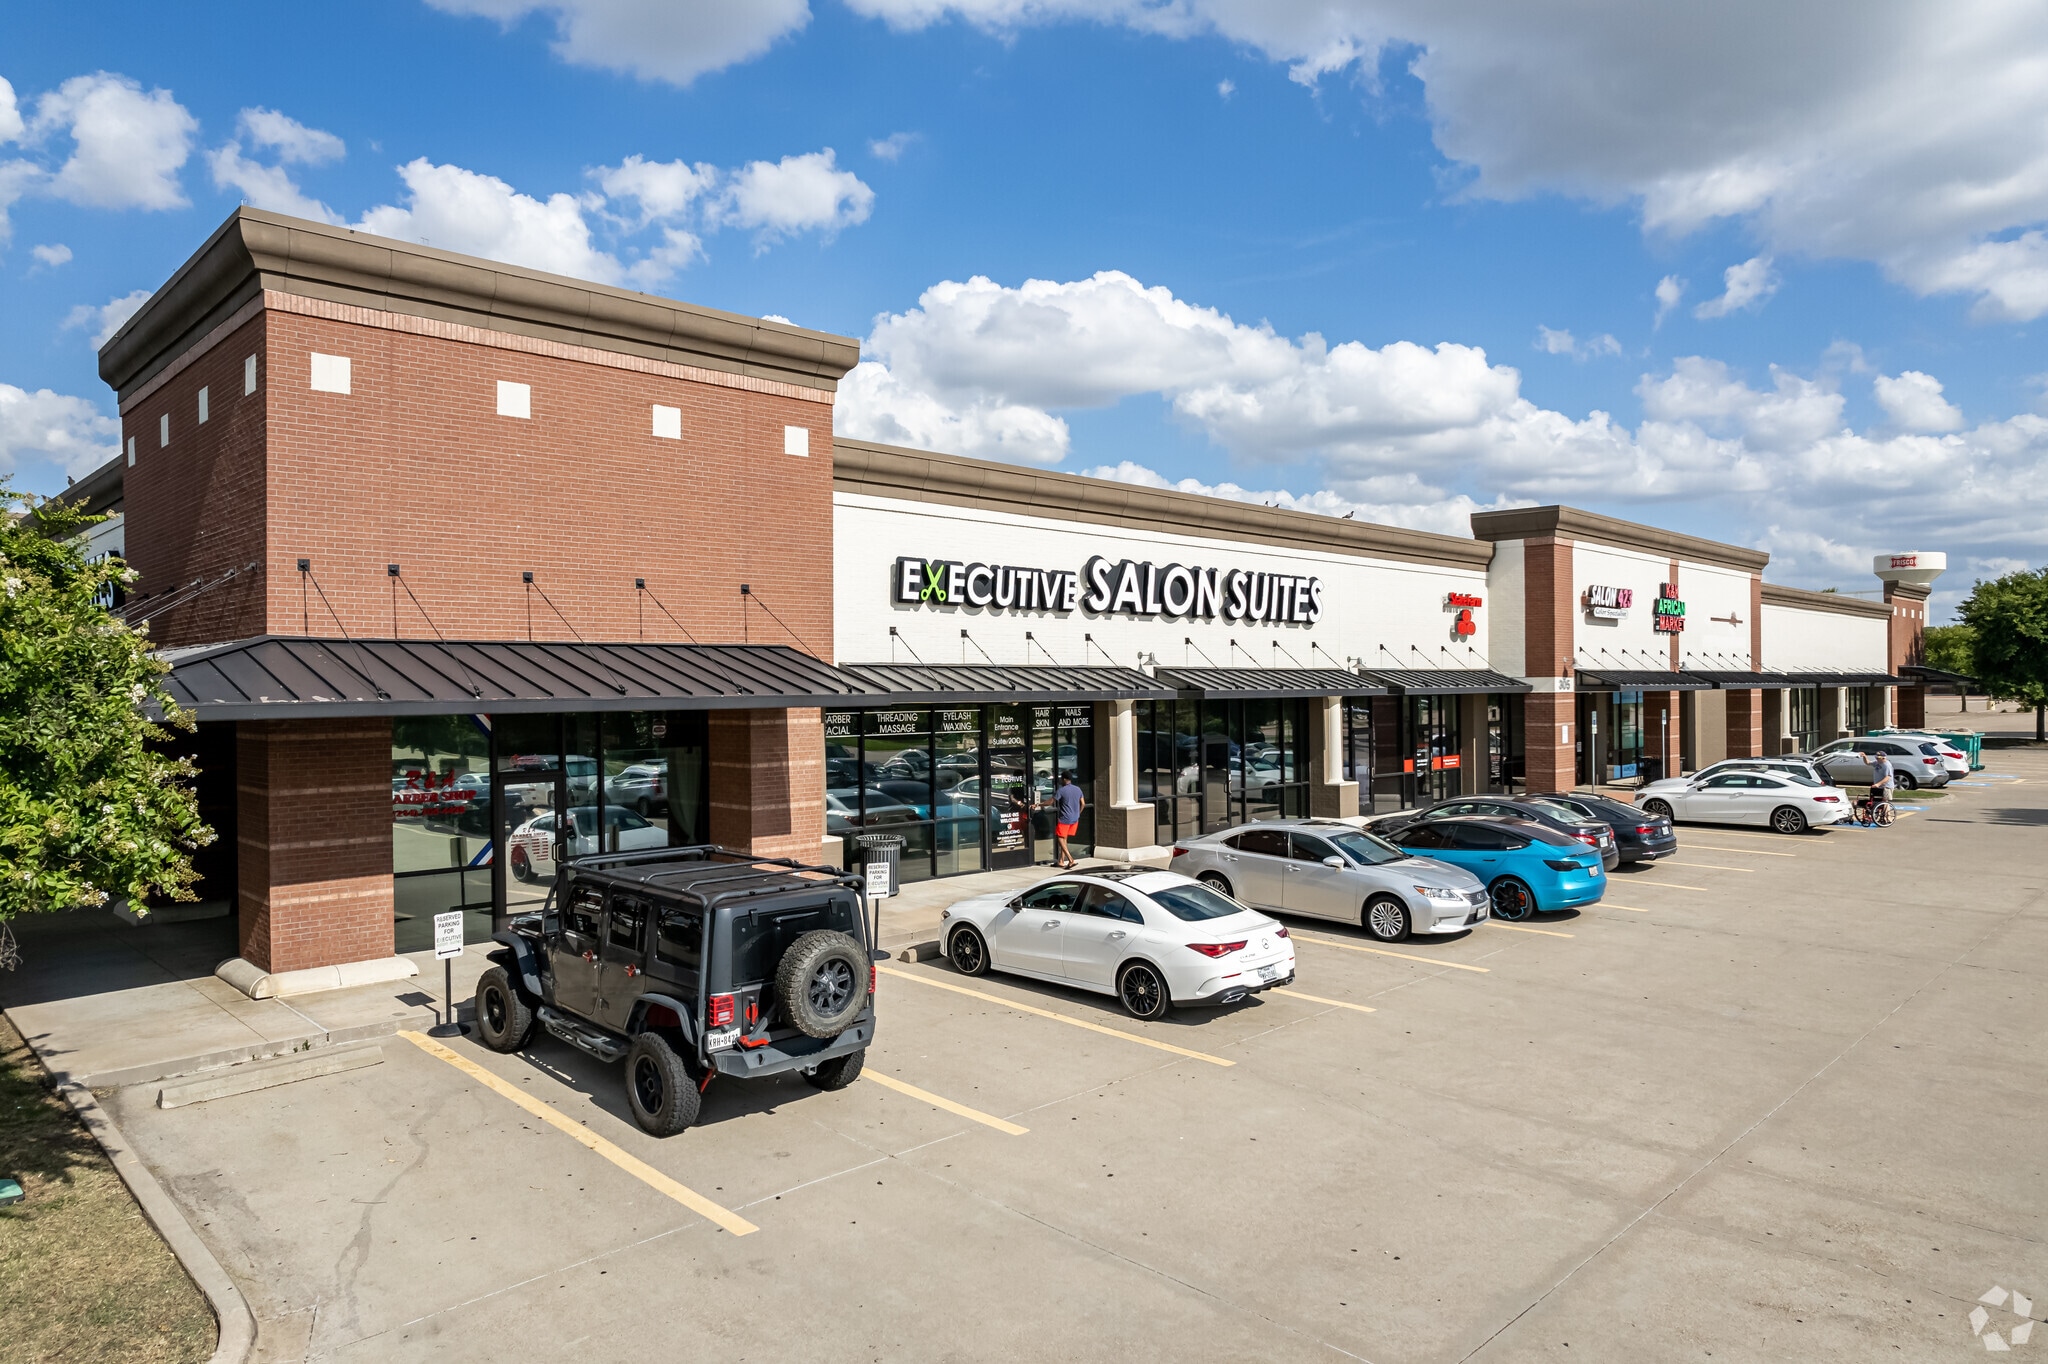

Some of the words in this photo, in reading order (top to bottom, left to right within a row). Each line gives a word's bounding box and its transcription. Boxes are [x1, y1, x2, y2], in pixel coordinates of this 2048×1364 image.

[902, 560, 1077, 610] EXECUTIVE
[1088, 558, 1221, 618] SALON
[1228, 573, 1324, 624] SUITES
[1591, 585, 1617, 607] SALON
[1618, 589, 1632, 608] 423
[1658, 598, 1685, 616] AFRICAN
[1659, 615, 1685, 632] MARKET
[1559, 679, 1570, 690] 305
[877, 712, 918, 722] THREADING
[943, 711, 971, 721] EYELASH
[1035, 709, 1049, 717] HAIR
[1065, 708, 1082, 716] NAILS
[825, 714, 851, 724] ARBER
[1035, 719, 1050, 727] SKIN
[1058, 718, 1071, 726] AND
[1073, 717, 1089, 726] MORE
[825, 725, 850, 735] ACIAL
[880, 723, 916, 733] MASSAGE
[943, 722, 972, 731] WAXING
[994, 723, 1019, 731] Entrance
[1008, 737, 1021, 745] 200
[405, 770, 422, 789] R
[393, 792, 439, 804] ARBER
[441, 790, 477, 801] SHOP
